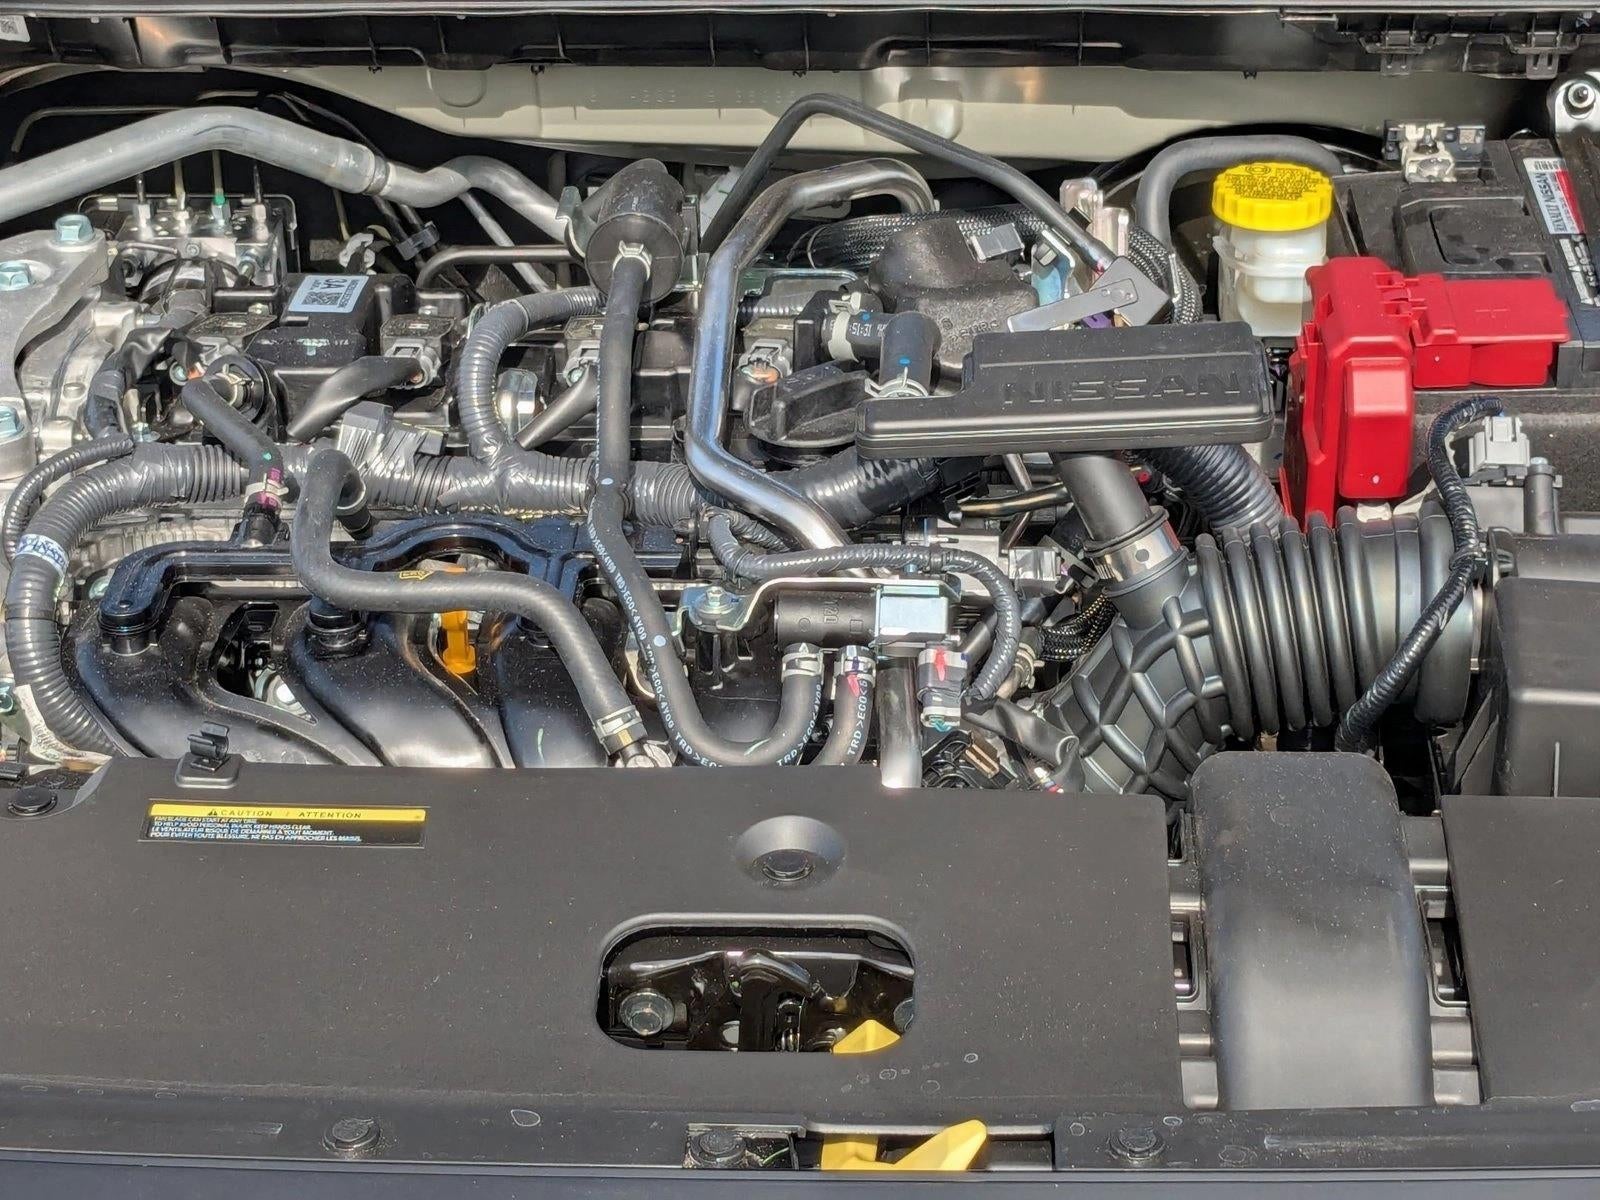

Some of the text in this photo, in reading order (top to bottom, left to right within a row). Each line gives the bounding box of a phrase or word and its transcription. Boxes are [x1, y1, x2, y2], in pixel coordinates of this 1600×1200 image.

[1002, 370, 1241, 404] NISSAN
[220, 809, 273, 817] CAUTION
[298, 811, 362, 819] ATTENTION
